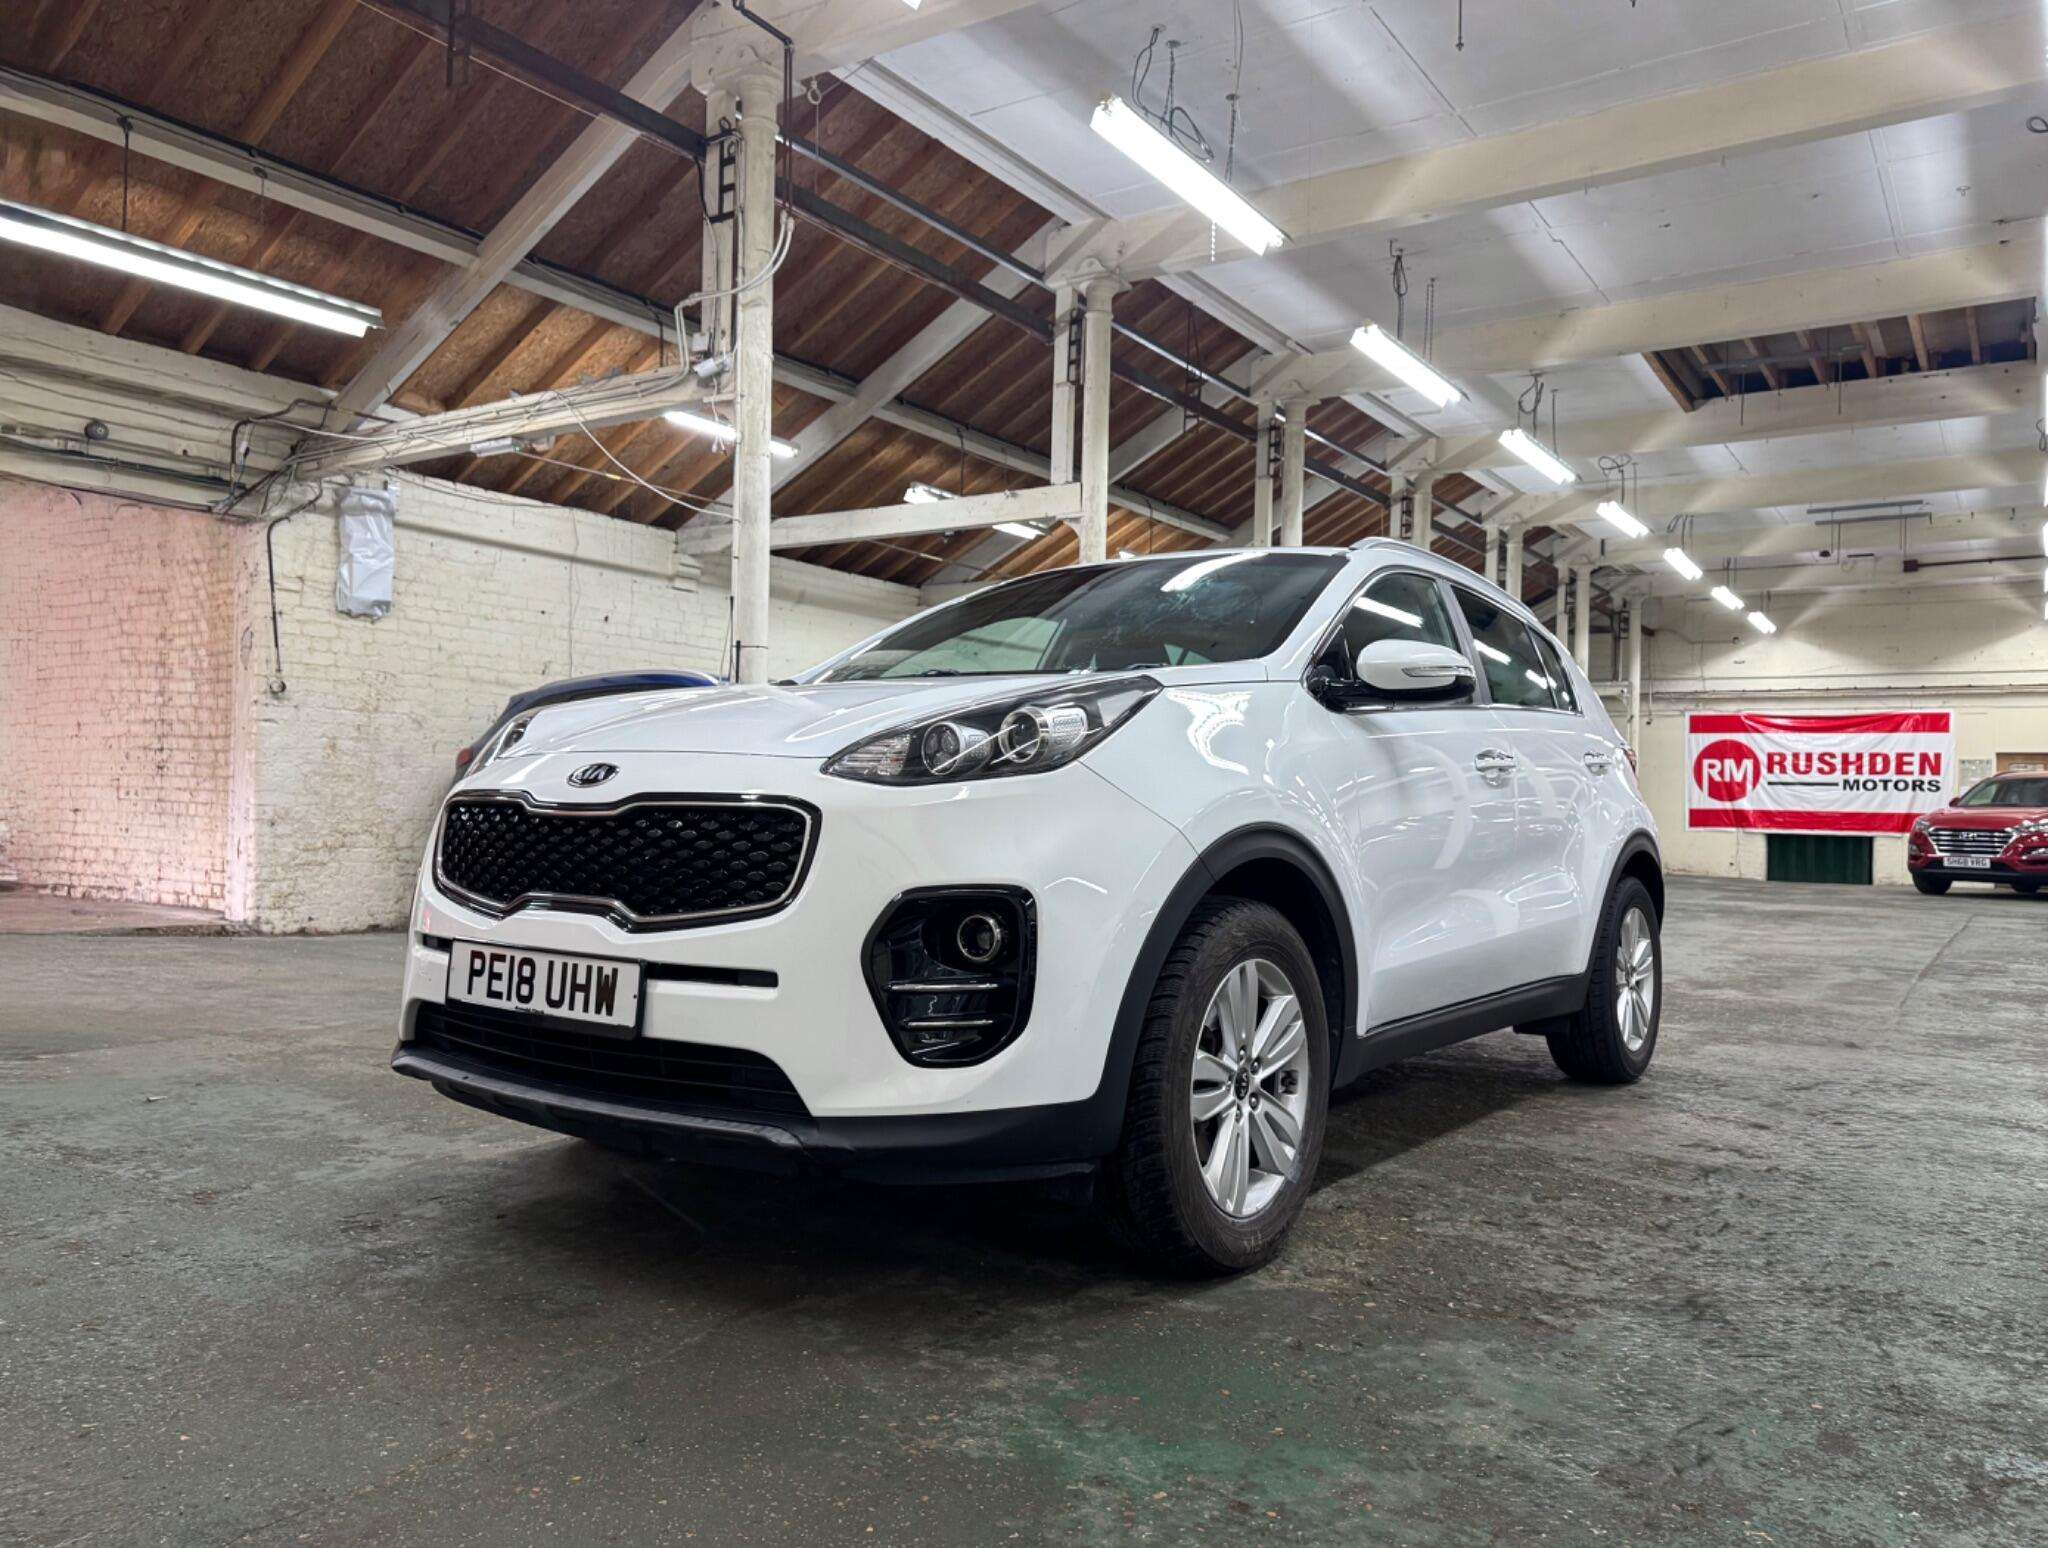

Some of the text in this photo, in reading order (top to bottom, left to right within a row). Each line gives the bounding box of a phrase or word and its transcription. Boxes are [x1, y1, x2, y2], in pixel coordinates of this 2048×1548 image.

[1702, 758, 1754, 794] RM
[1766, 752, 1942, 775] RUSHDEN
[1842, 779, 1942, 792] MOTORS
[467, 950, 618, 1016] PE18 UHW
